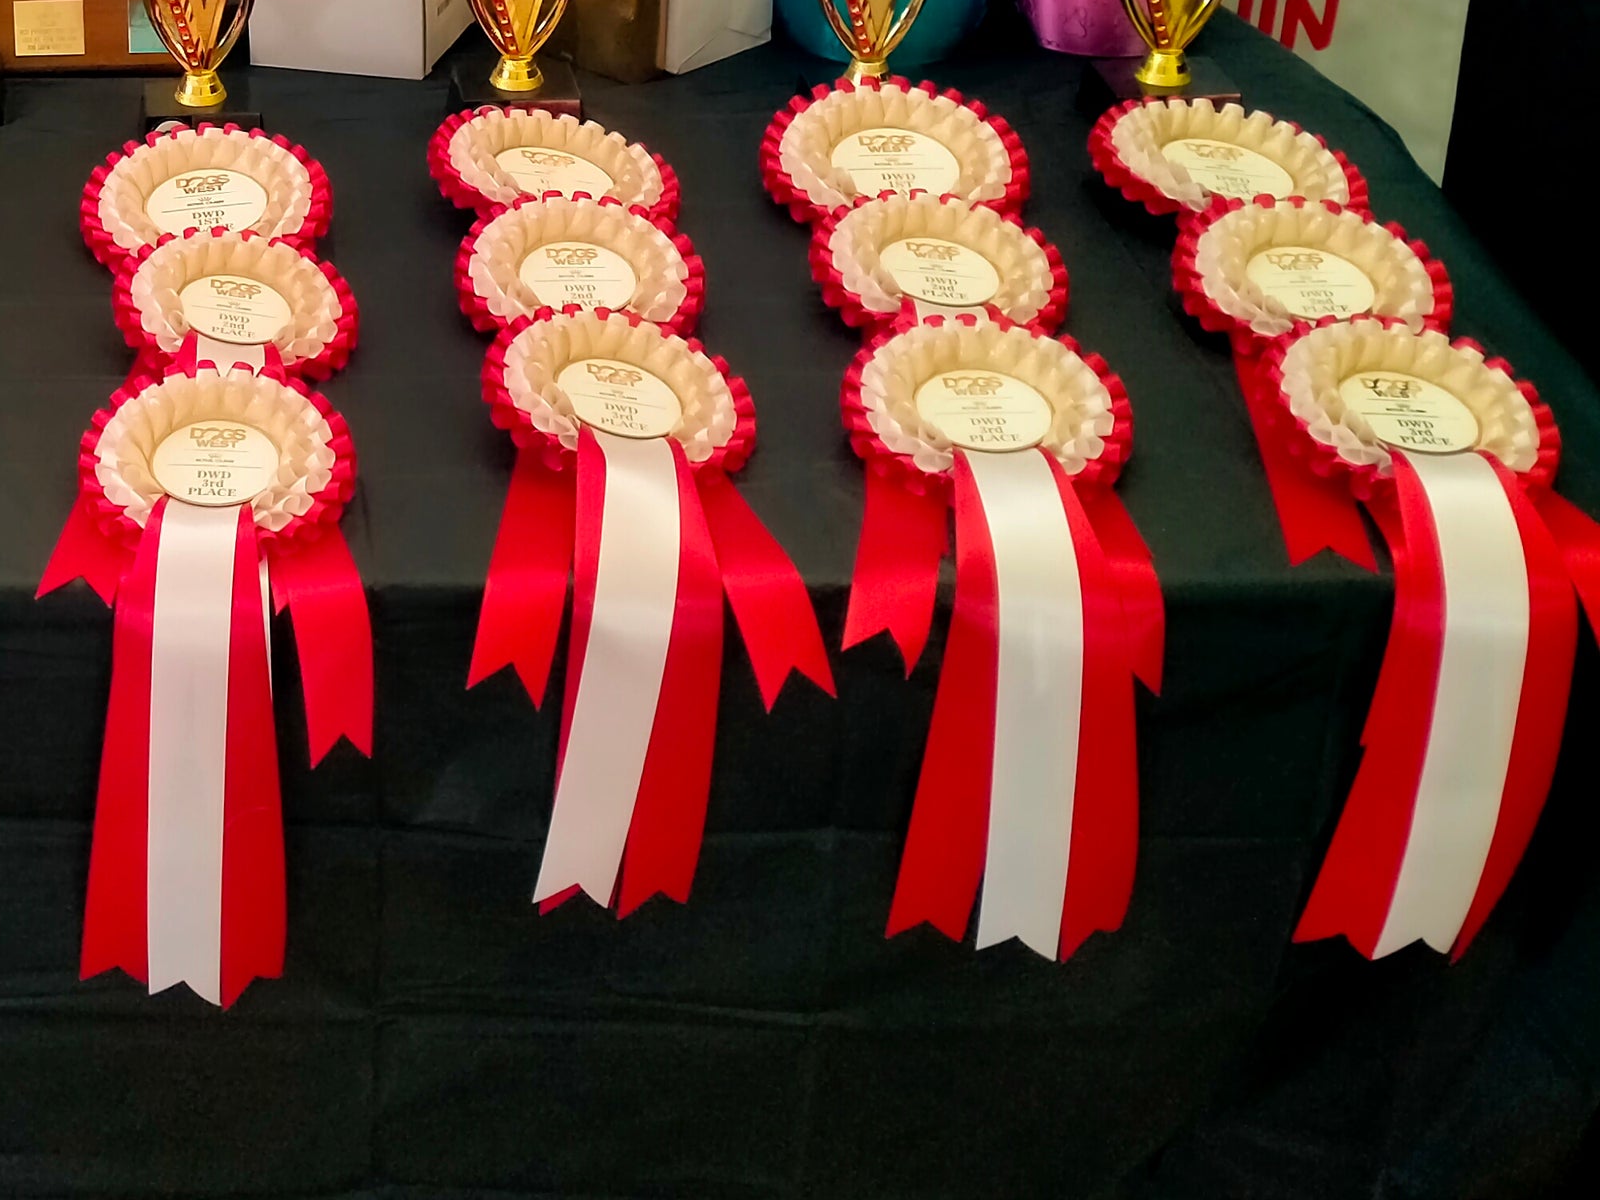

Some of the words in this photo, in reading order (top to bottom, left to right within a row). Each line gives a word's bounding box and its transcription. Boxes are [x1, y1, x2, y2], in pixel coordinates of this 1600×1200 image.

[867, 145, 911, 153] WEST
[882, 173, 916, 181] DWD
[183, 184, 224, 194] WEST
[192, 210, 225, 219] DWD
[198, 217, 222, 226] 1ST
[553, 258, 593, 266] WEST
[925, 276, 958, 286] DWD
[564, 284, 597, 292] DWD
[933, 284, 955, 292] 2nd
[571, 292, 593, 300] 2nd
[922, 289, 968, 299] PLACE
[1300, 289, 1334, 298] DWD
[219, 313, 250, 324] DWD
[211, 326, 255, 338] PLACE
[604, 402, 639, 415] DWD
[601, 417, 649, 431] PLACE
[969, 417, 1007, 426] DWD
[1396, 419, 1434, 429] DWD
[980, 426, 1004, 434] 3rd
[969, 434, 1020, 442] PLACE
[1399, 435, 1452, 446] PLACE
[196, 439, 240, 448] WEST
[197, 470, 231, 479] DWD
[202, 479, 224, 488] 3rd
[188, 487, 237, 497] PLACE
